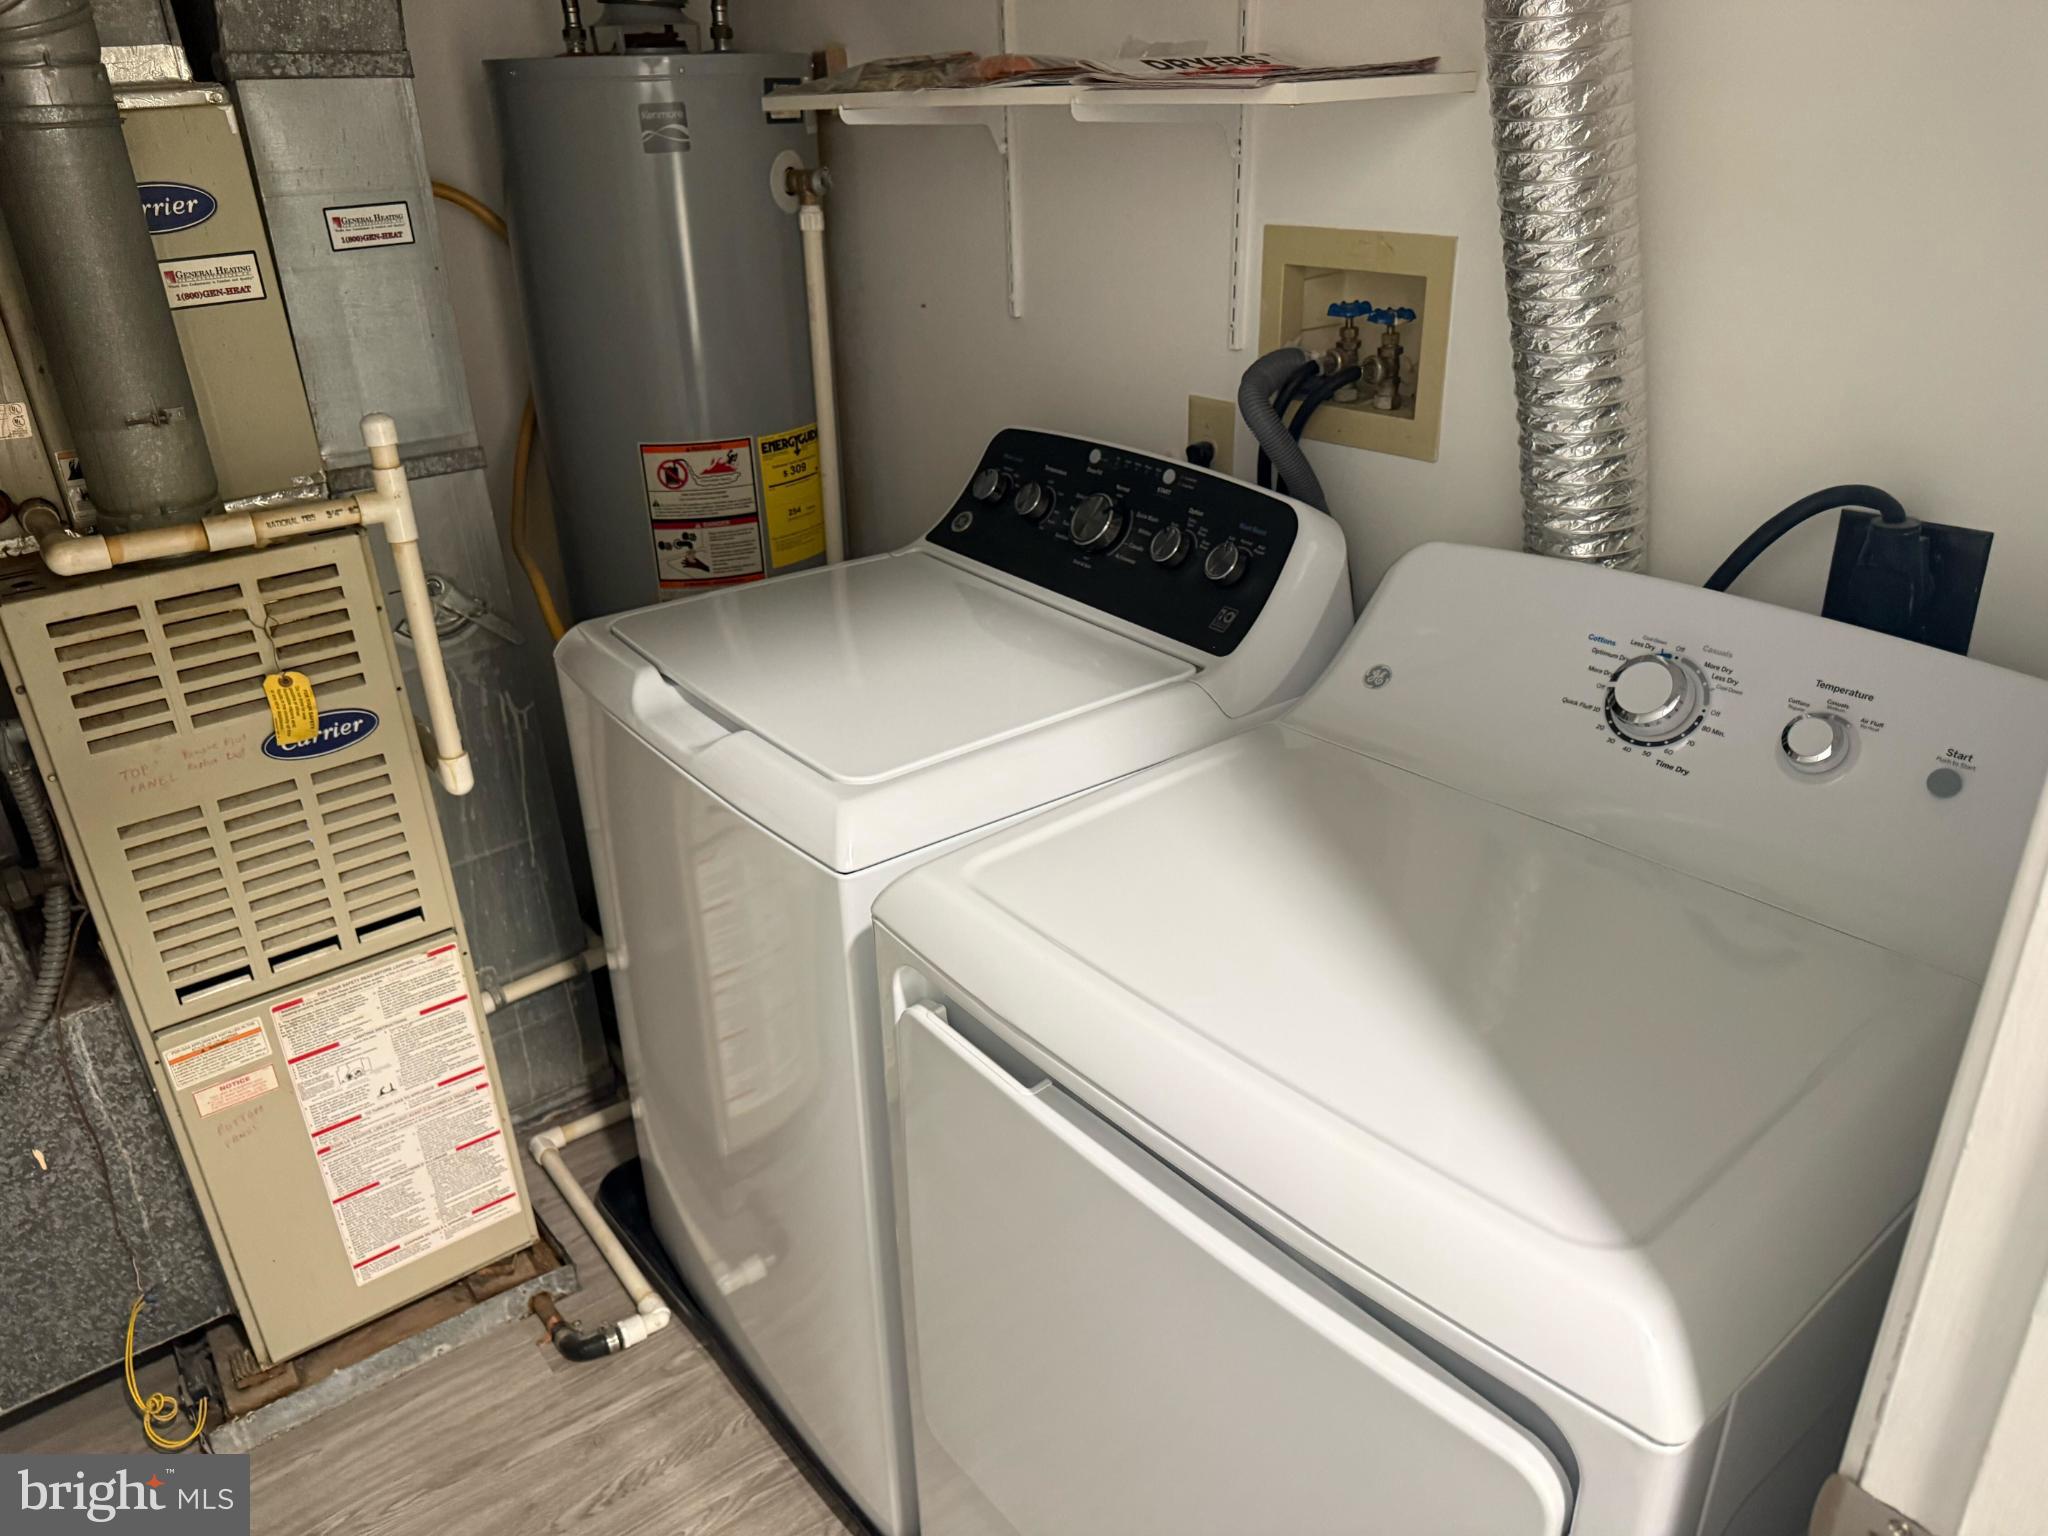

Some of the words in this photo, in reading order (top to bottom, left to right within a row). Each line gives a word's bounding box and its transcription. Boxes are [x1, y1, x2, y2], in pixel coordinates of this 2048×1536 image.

[1141, 55, 1270, 70] DRYERS
[142, 197, 198, 217] rrier
[342, 216, 373, 225] GENERAL
[175, 269, 213, 280] GENERAL
[214, 265, 251, 275] HEATING
[176, 285, 252, 301] 1(800)GEN-HEAT
[1588, 633, 1616, 647] Cottons
[1630, 639, 1644, 648] Less
[1644, 641, 1656, 652] Dry
[1702, 645, 1733, 658] Casuals
[1704, 661, 1719, 672] More
[1719, 665, 1733, 675] Dry
[1711, 673, 1726, 683] Less
[1726, 677, 1739, 686] Dry
[1816, 679, 1875, 702] Temperature
[1561, 697, 1578, 707] Quick
[1945, 748, 1974, 763] Start
[1655, 759, 1674, 771] Time
[1675, 765, 1690, 776] Dry
[219, 1076, 250, 1091] NOTICE
